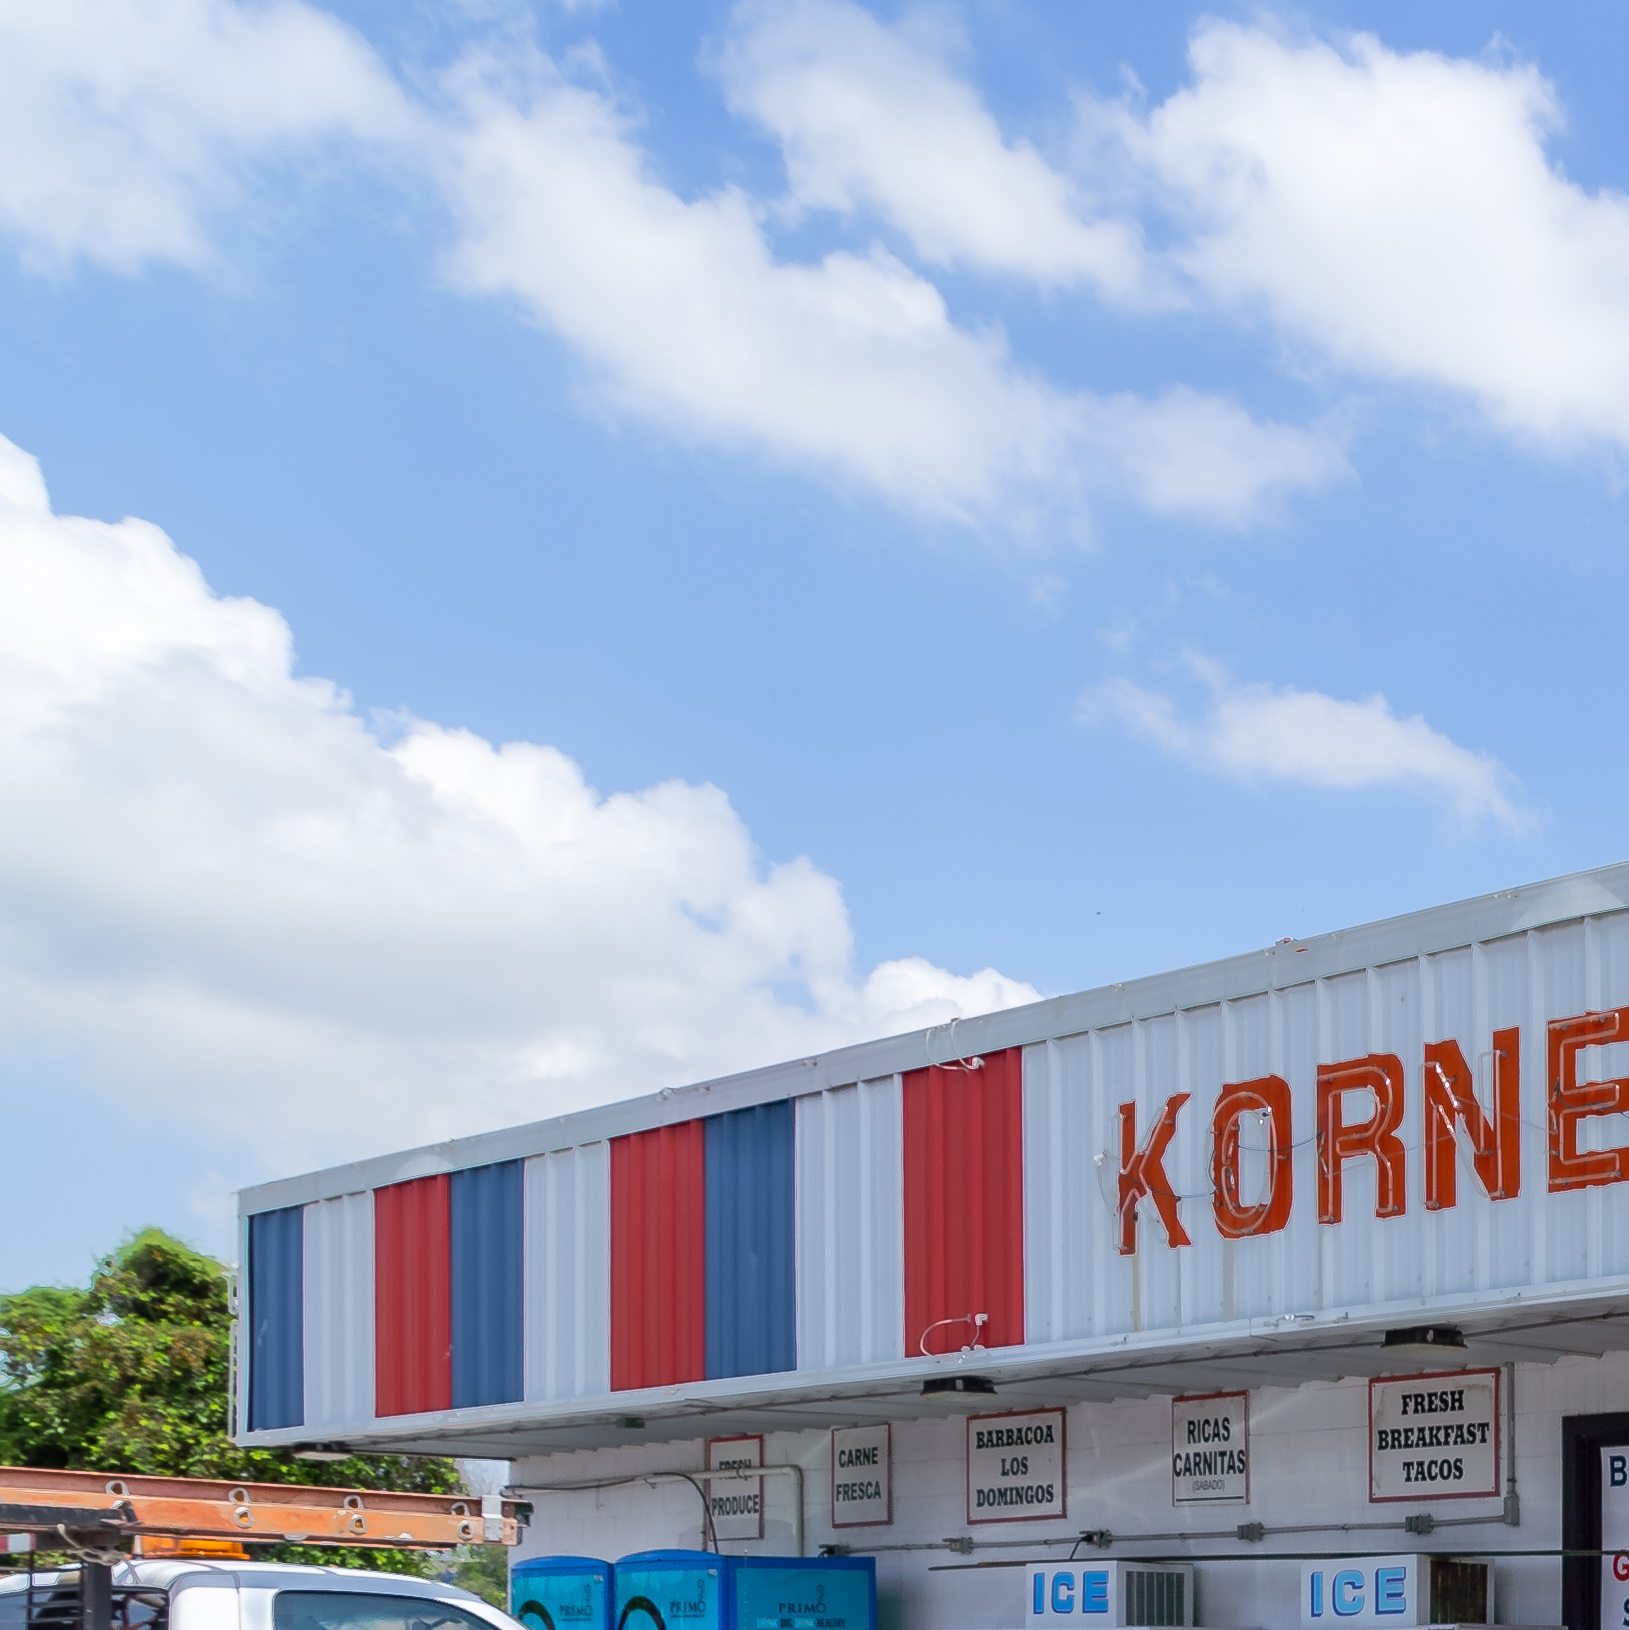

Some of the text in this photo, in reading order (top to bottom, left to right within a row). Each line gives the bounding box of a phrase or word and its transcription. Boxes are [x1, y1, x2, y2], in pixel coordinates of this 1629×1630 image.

[1401, 1389, 1465, 1416] FRESH
[975, 1424, 1054, 1450] BARBACOA
[1187, 1416, 1231, 1445] RICAS
[1377, 1422, 1490, 1451] BREAKFAST
[838, 1447, 879, 1468] CARNE
[1000, 1456, 1029, 1477] LOS
[1173, 1450, 1246, 1478] CARNITAS
[1402, 1458, 1464, 1483] TACOS
[835, 1480, 881, 1502] FRESCA
[975, 1484, 1054, 1508] DOMINGOS
[711, 1494, 759, 1516] PRODUCE
[1032, 1570, 1109, 1614] ICE
[1310, 1566, 1407, 1617] ICE
[669, 1600, 707, 1613] PRIMO
[778, 1602, 827, 1614] PRIMO
